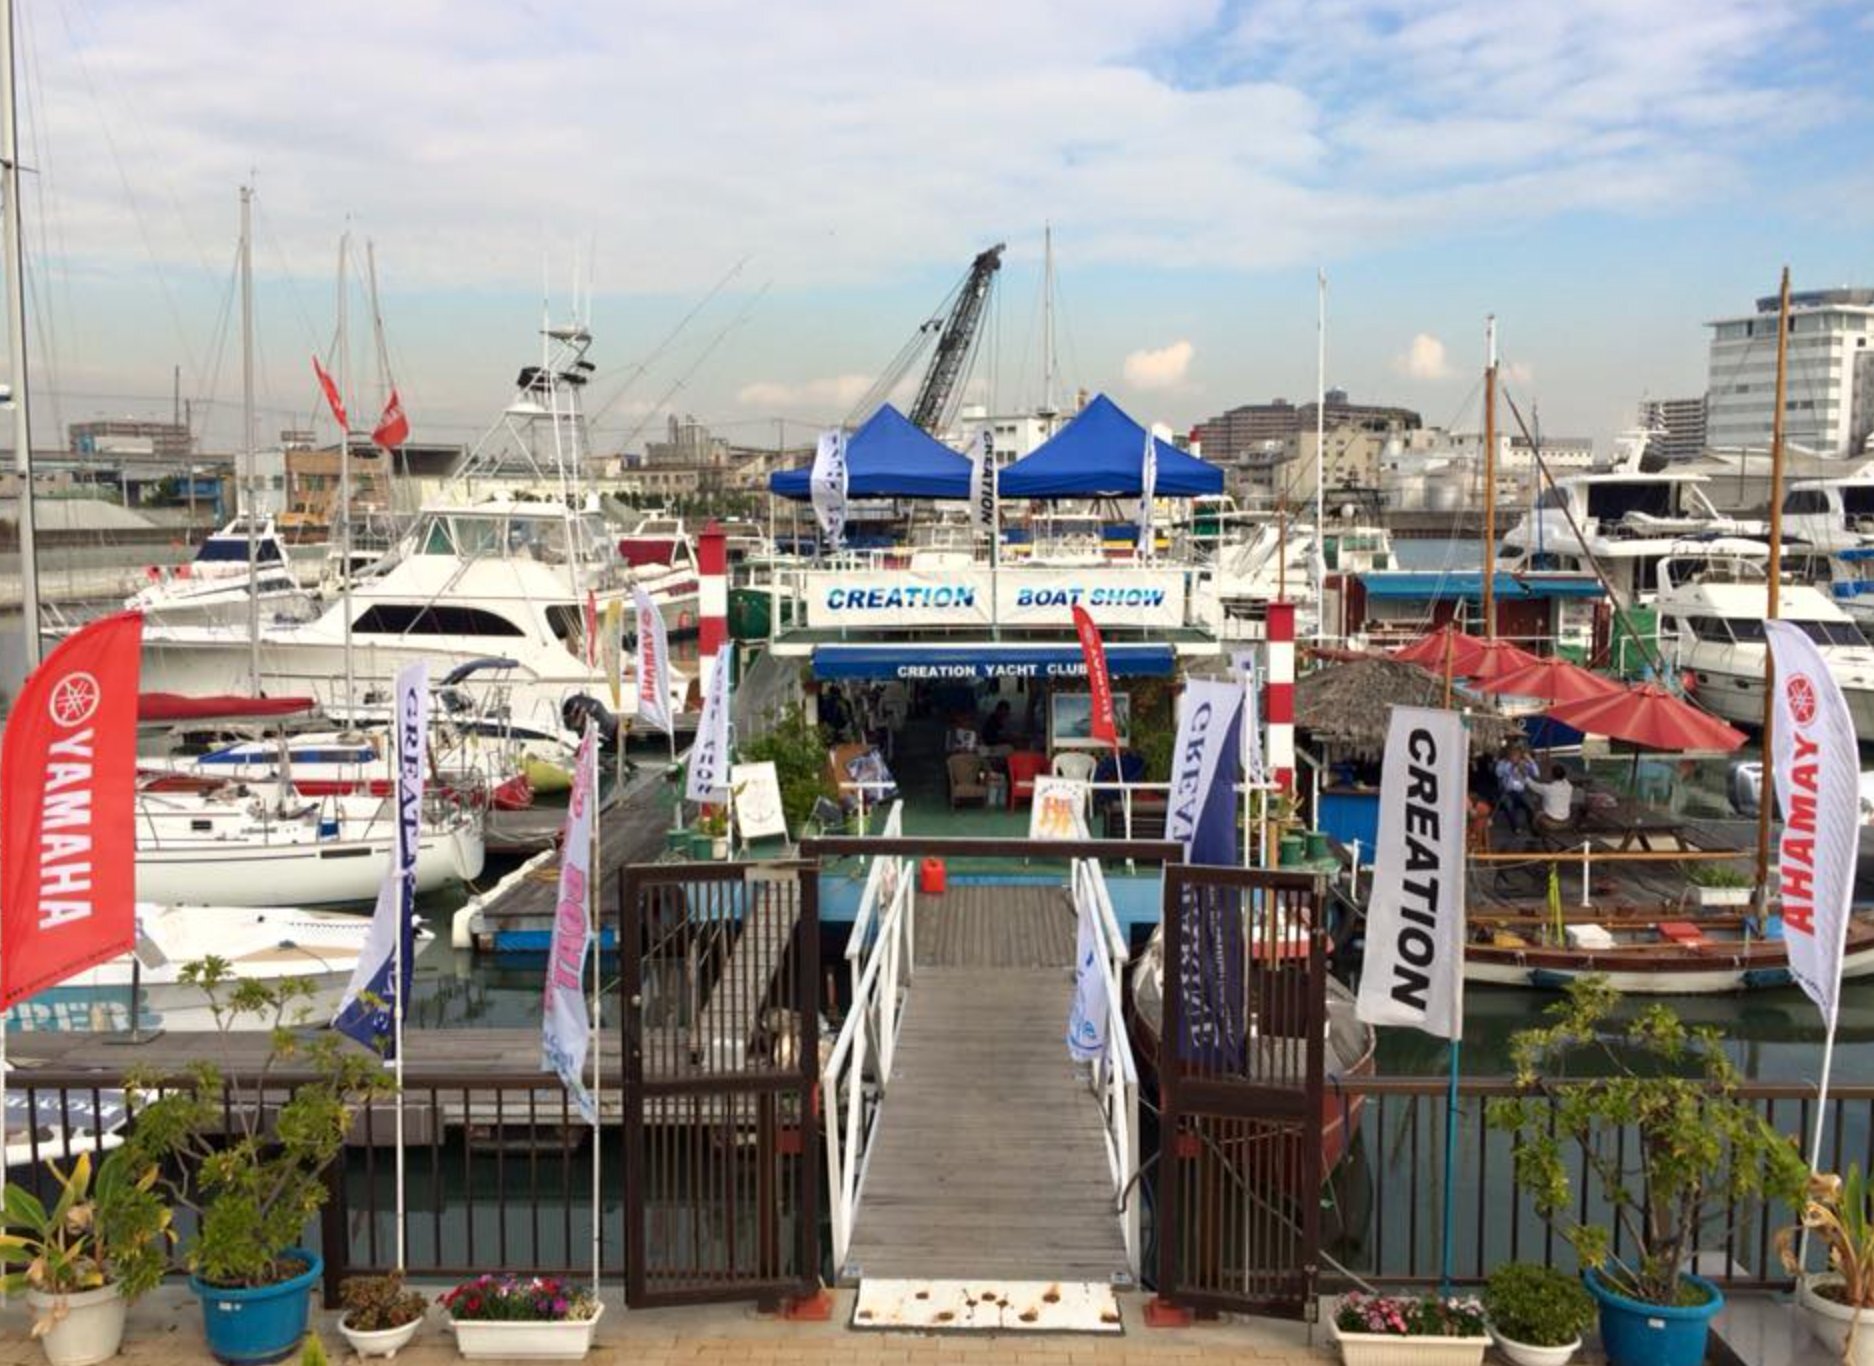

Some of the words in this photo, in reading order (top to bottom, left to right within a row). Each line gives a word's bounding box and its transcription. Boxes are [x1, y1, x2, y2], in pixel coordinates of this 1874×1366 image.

[981, 431, 994, 525] CREATION
[827, 586, 975, 610] CREATION
[1017, 588, 1084, 606] BOAT
[1090, 588, 1166, 607] SHOW
[897, 665, 977, 678] CREATION
[985, 664, 1038, 677] YACHT
[1047, 662, 1089, 676] CLUB
[402, 687, 419, 838] GREAT
[38, 727, 94, 932] YAMAHA
[1390, 728, 1440, 1012] CREATION
